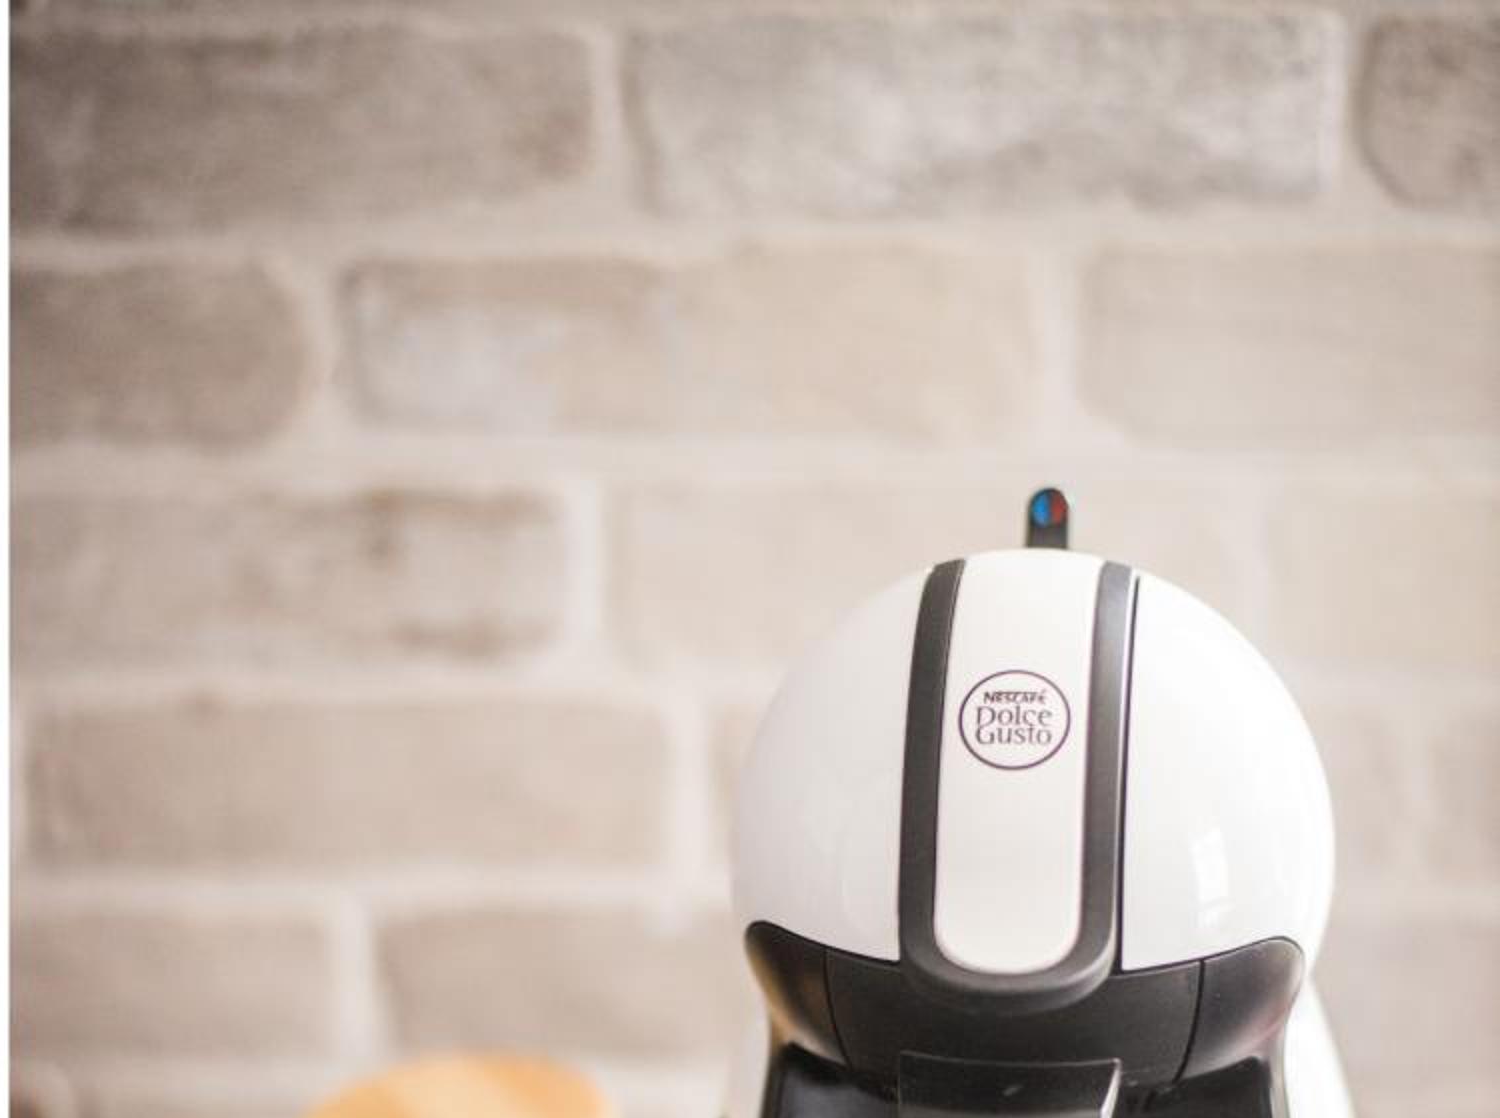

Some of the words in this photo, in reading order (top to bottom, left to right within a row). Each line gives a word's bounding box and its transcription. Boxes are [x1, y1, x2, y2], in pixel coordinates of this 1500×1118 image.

[983, 689, 1047, 704] NESCAFÉ
[976, 705, 1053, 728] Dolce
[975, 724, 1053, 746] Gusto
